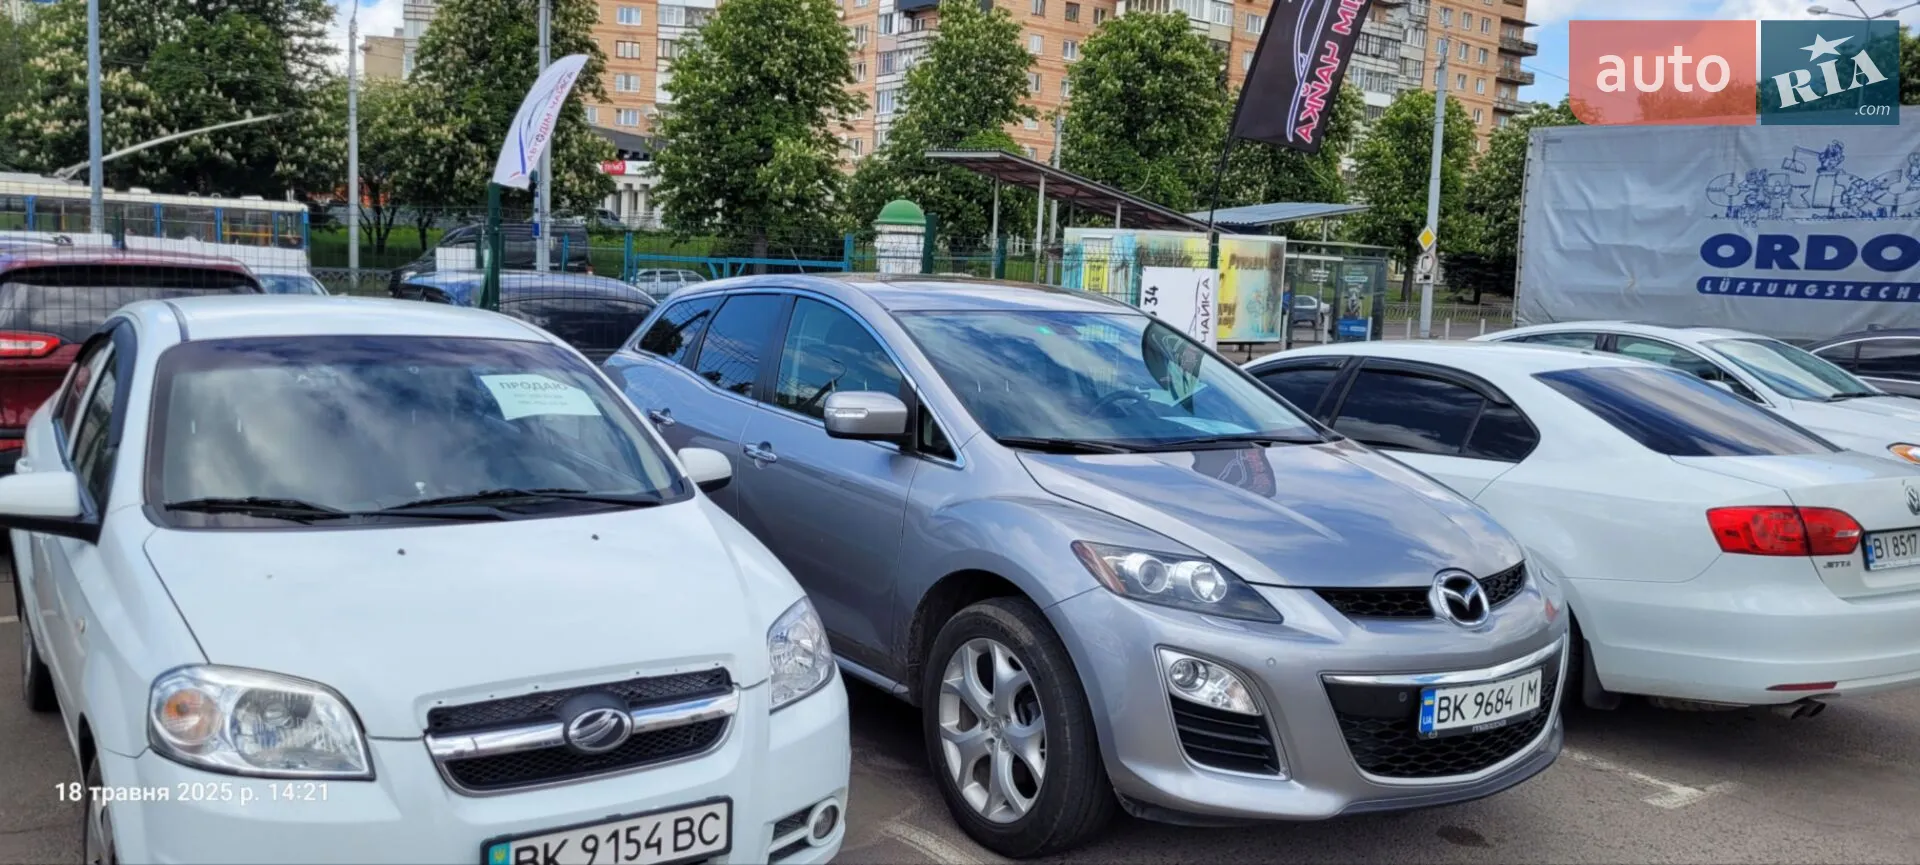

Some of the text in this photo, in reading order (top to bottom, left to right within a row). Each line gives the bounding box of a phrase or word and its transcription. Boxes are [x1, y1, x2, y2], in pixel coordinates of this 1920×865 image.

[1144, 286, 1159, 306] 34
[1704, 277, 1920, 299] LÜFTUNGSTECH
[1198, 277, 1210, 343] ЧАЙКА
[1892, 533, 1917, 557] 8517
[1823, 560, 1851, 569] JETTA
[1437, 678, 1539, 724] BK 9684 IM
[580, 821, 663, 865] 9154
[672, 811, 721, 853] BC
